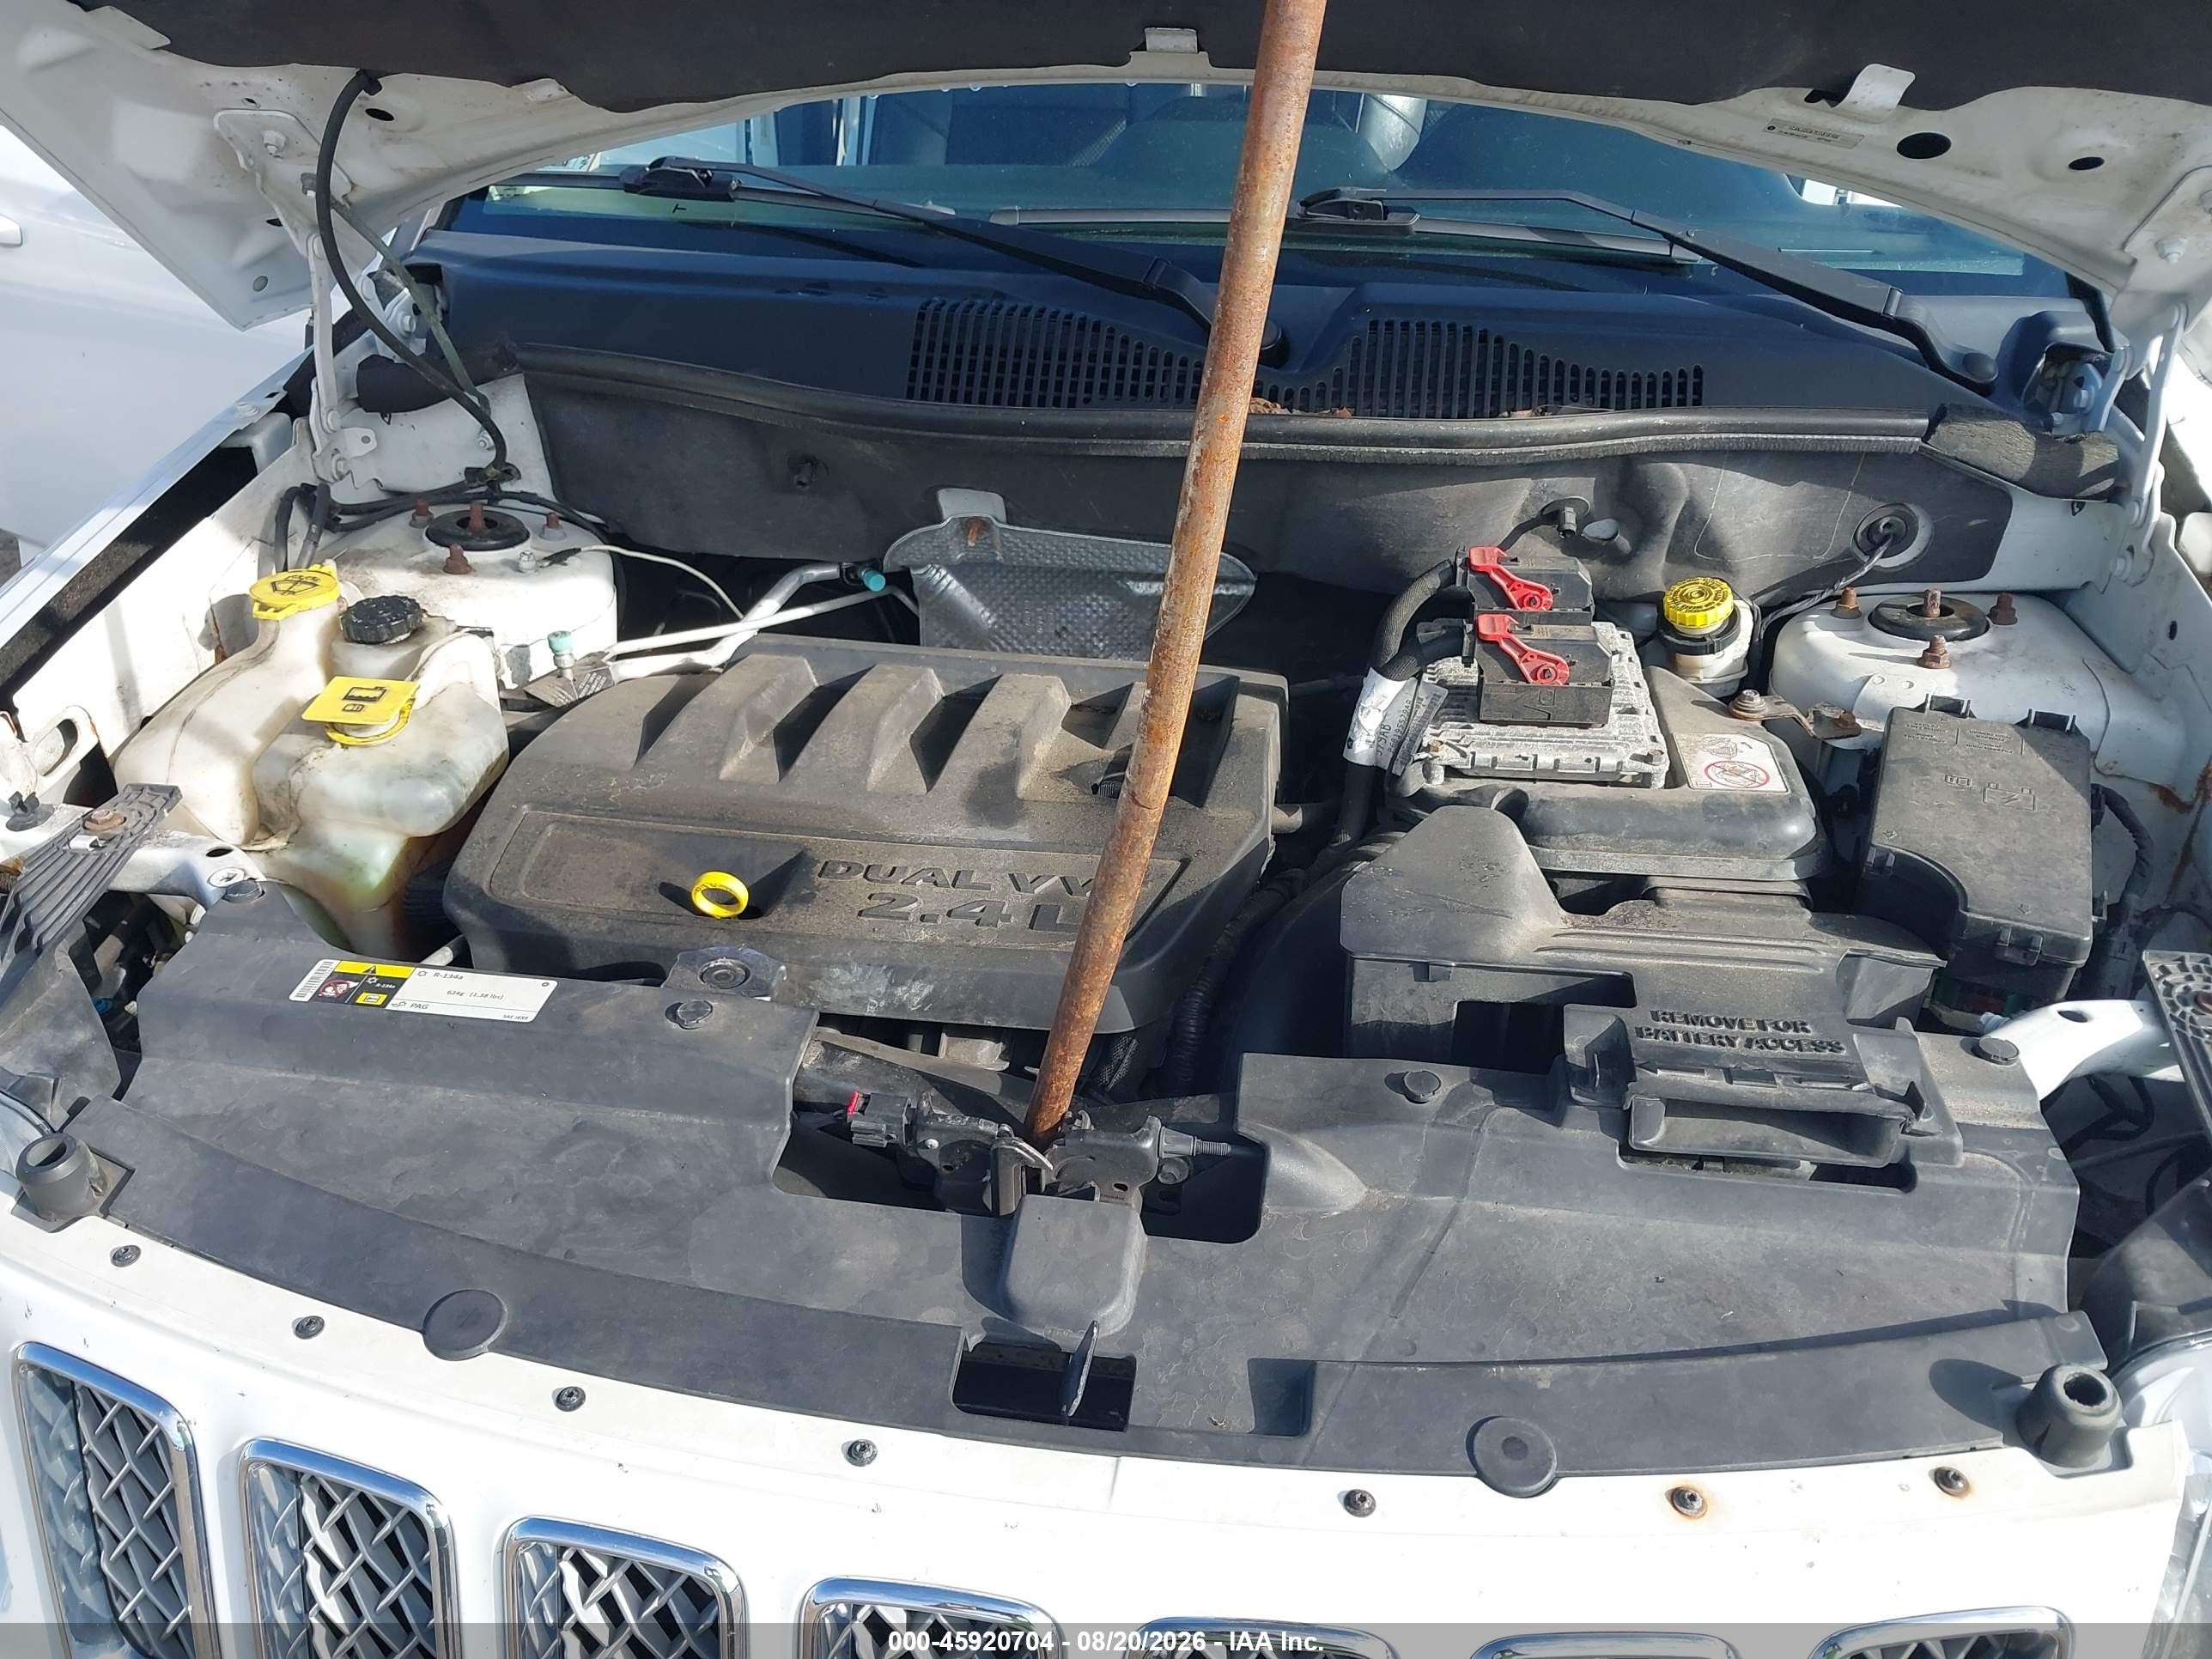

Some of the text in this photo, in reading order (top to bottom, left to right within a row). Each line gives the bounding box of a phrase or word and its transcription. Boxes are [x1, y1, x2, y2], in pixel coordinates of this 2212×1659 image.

[817, 860, 1094, 898] DUAL VV
[1650, 1010, 1812, 1034] REMOVE FOR
[1635, 1026, 1846, 1055] BATTERY ACCESS
